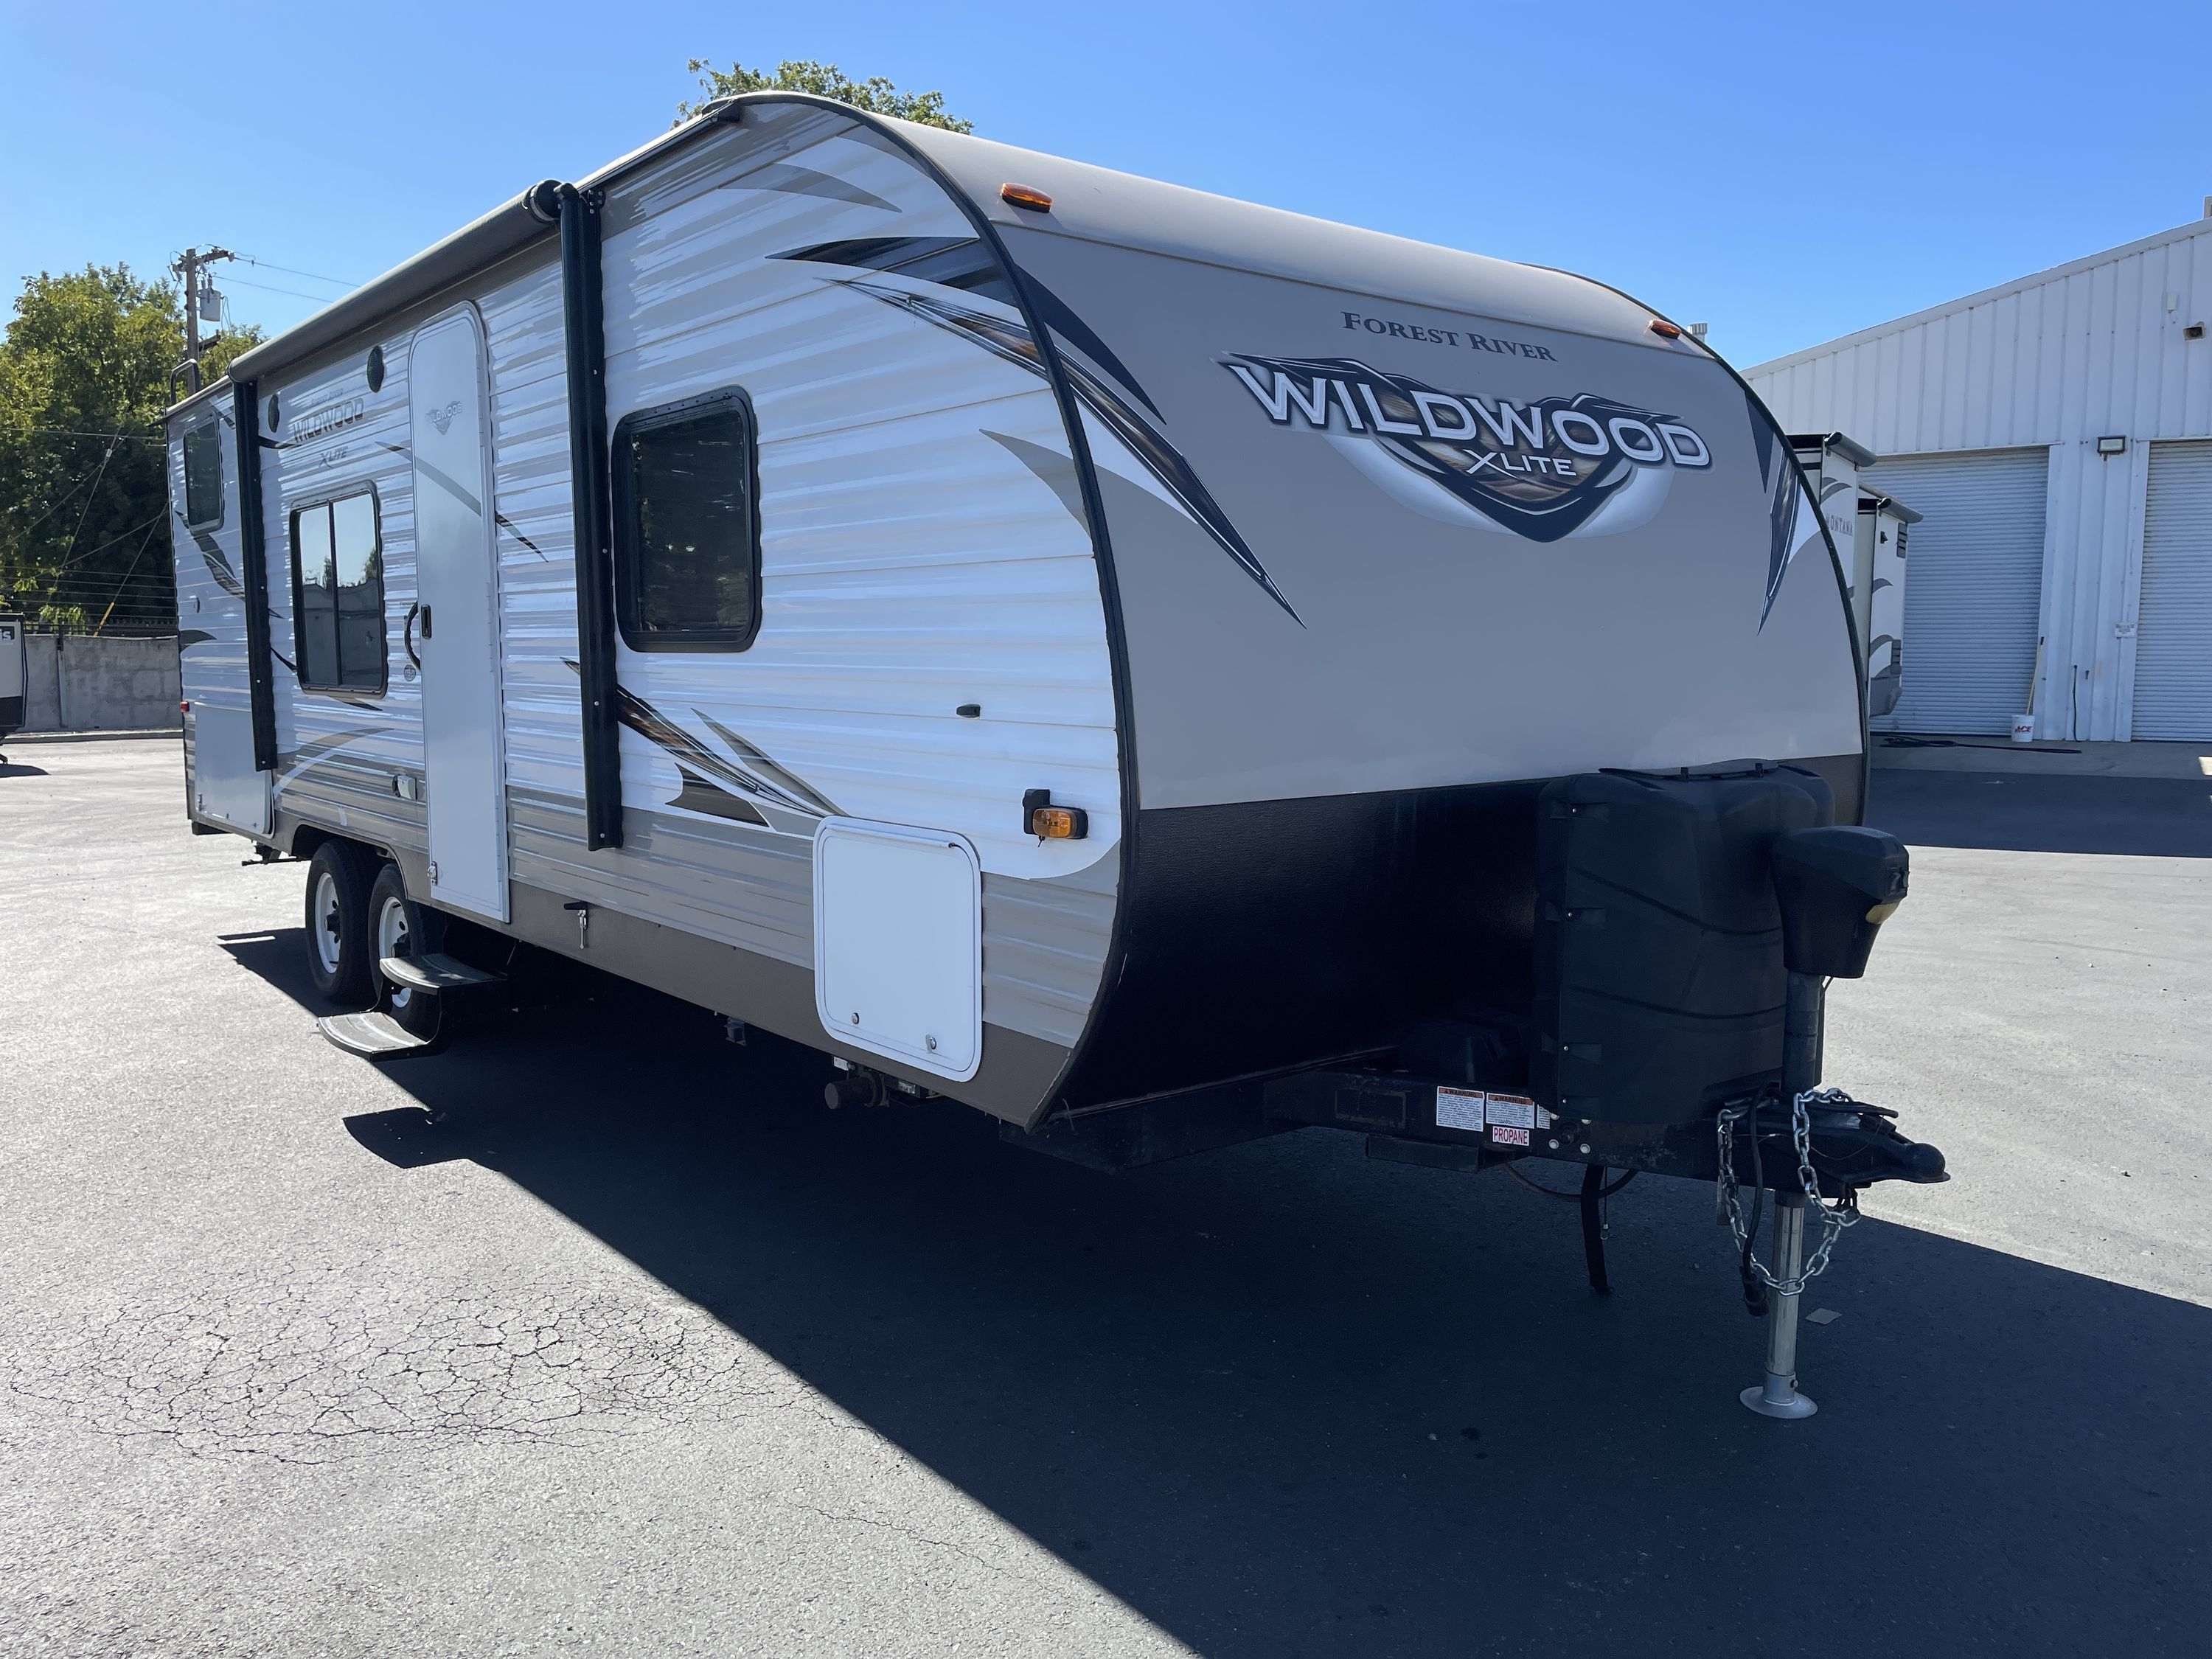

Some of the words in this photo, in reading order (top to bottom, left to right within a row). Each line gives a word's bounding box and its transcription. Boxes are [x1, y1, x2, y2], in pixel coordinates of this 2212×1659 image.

[1340, 310, 1459, 347] FOREST
[1467, 332, 1558, 362] RIVER
[293, 398, 364, 443] WILDWOOD
[1228, 364, 1711, 467] WILDWOOD
[1461, 448, 1576, 476] XLITE
[1494, 1127, 1528, 1144] PROPANE
